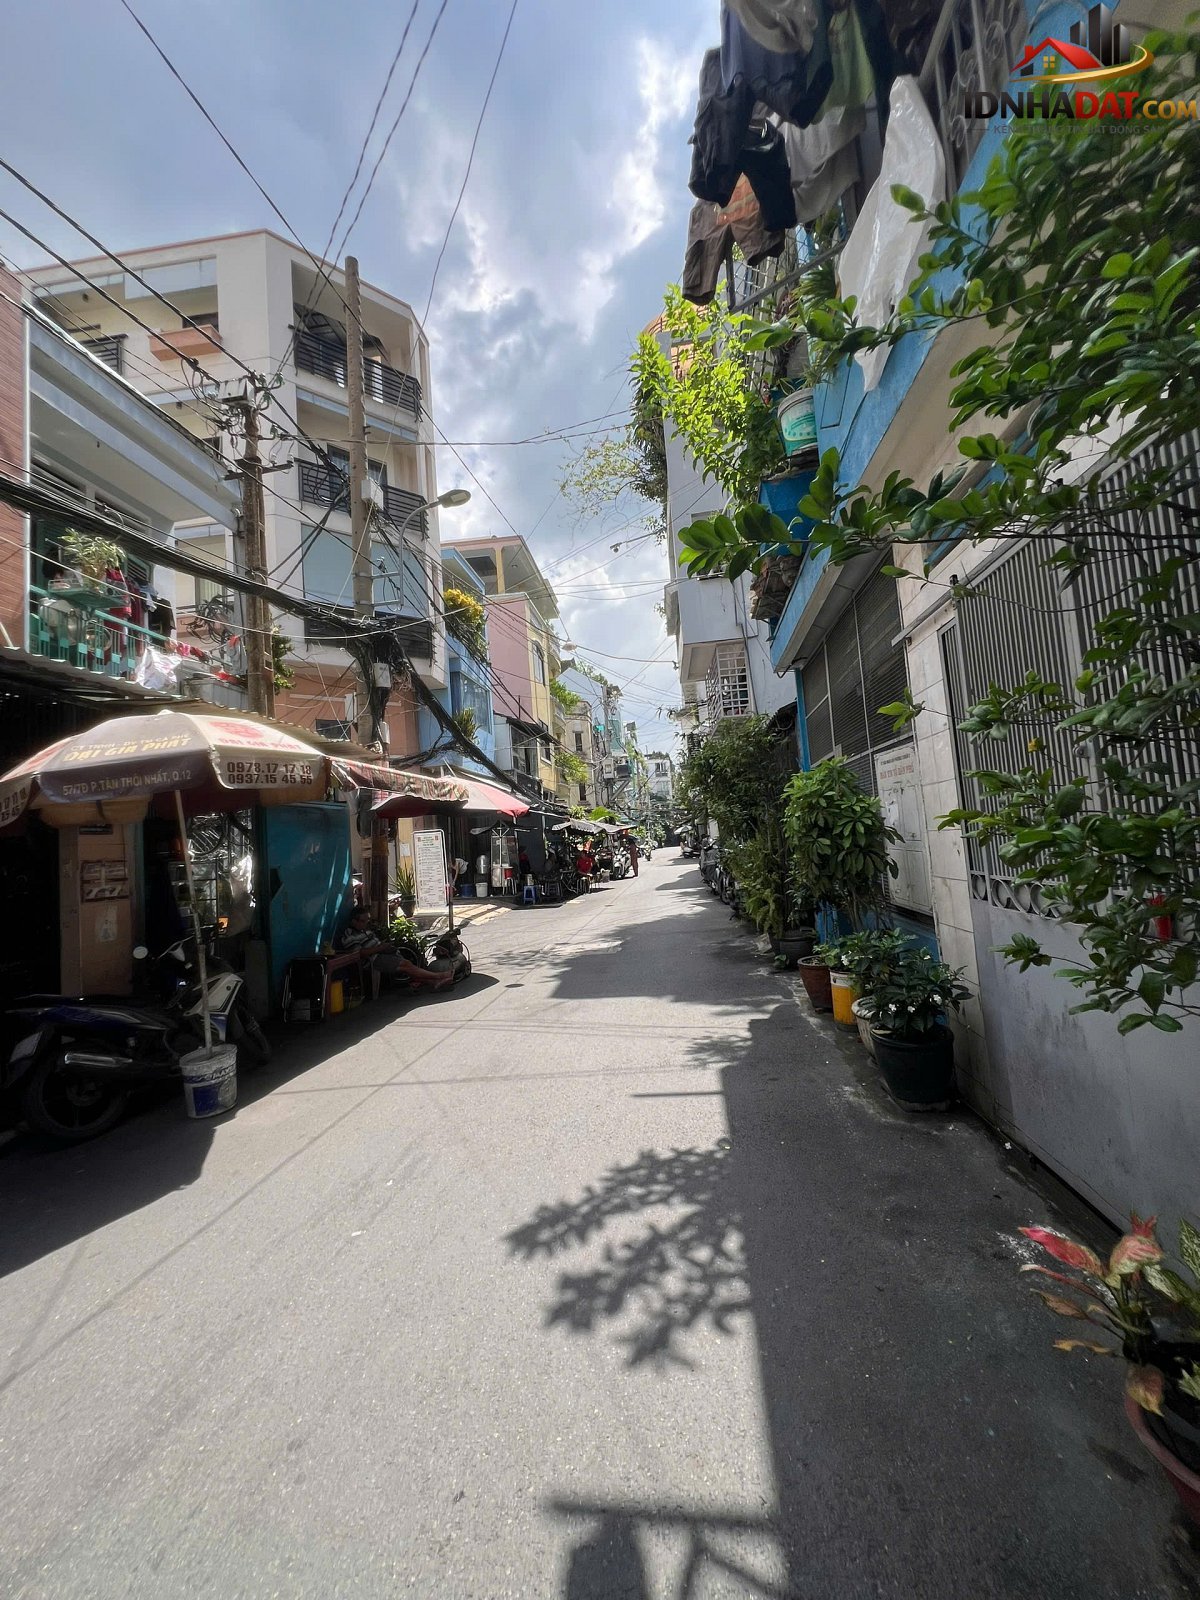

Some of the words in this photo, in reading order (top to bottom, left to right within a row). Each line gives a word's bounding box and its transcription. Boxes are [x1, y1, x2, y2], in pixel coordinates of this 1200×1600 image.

[227, 761, 279, 774] 0978.17
[283, 763, 296, 774] 17
[300, 764, 311, 775] 18
[228, 773, 277, 785] 0937.15
[281, 774, 297, 784] 45
[300, 775, 313, 785] 55
